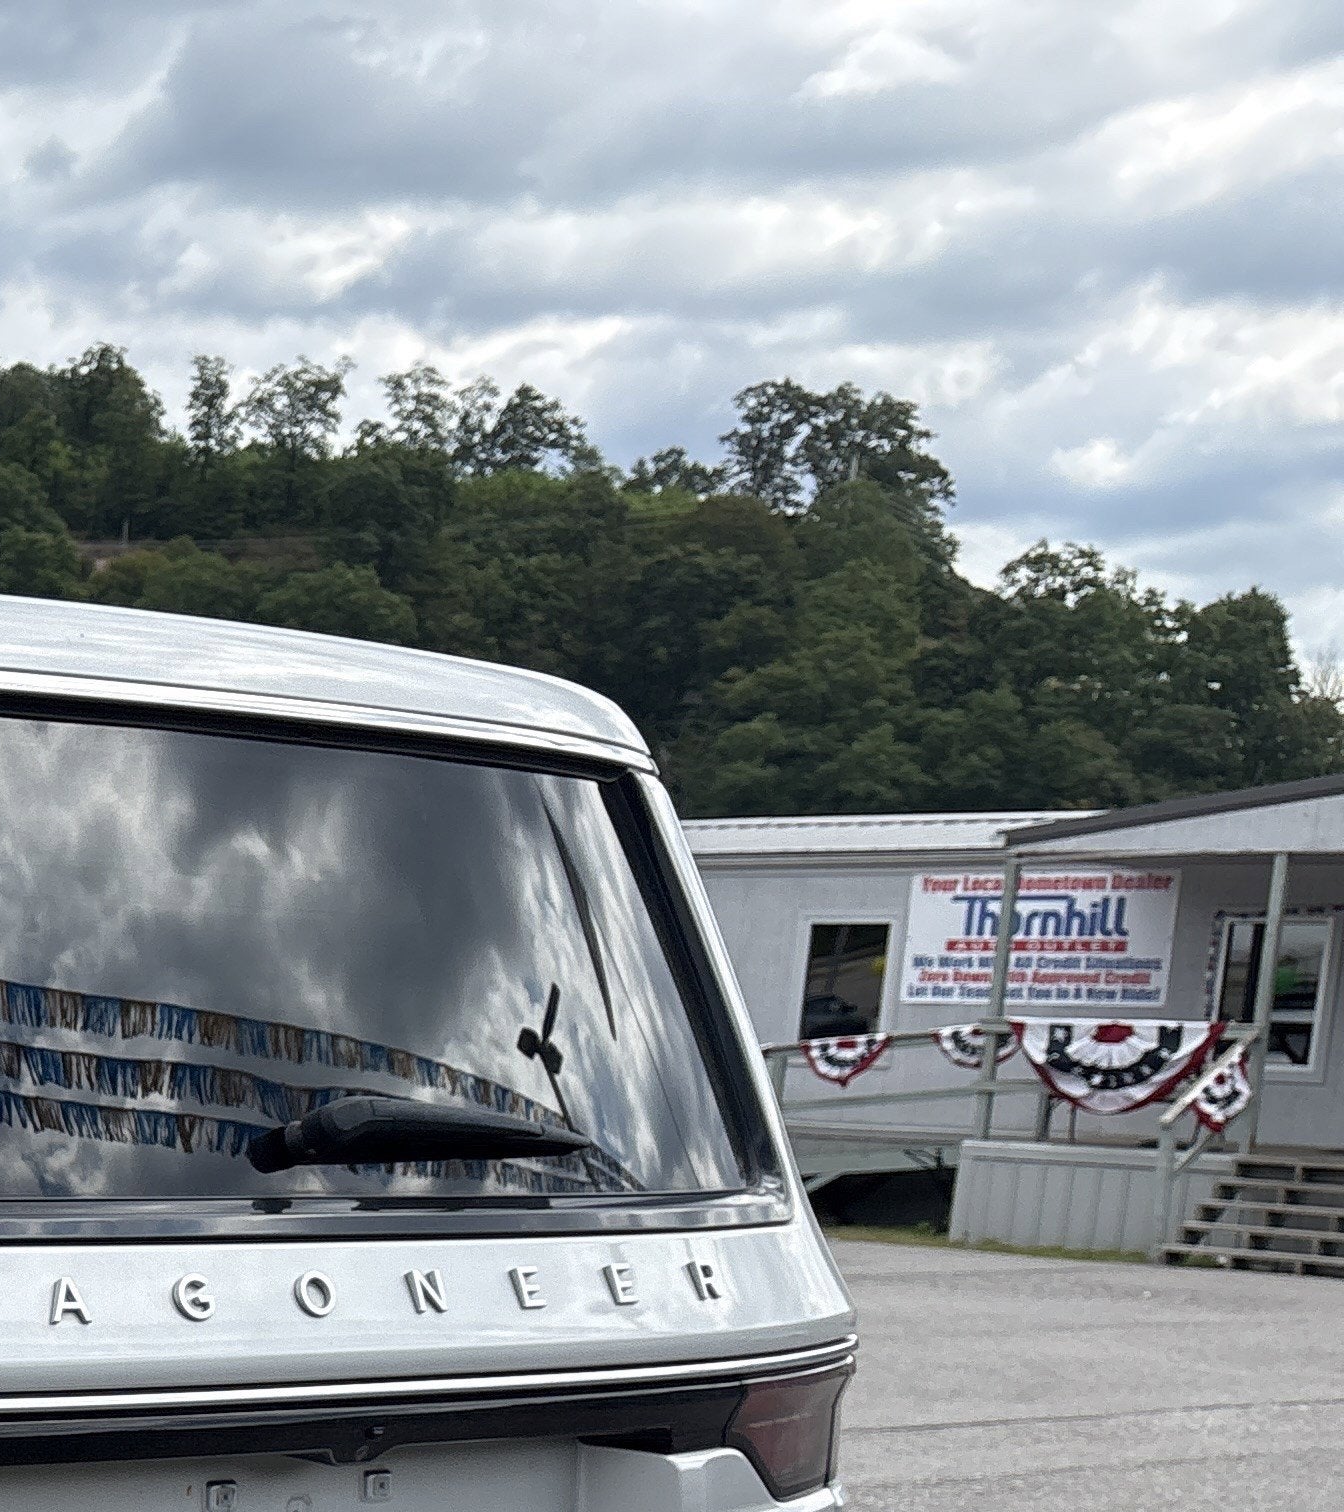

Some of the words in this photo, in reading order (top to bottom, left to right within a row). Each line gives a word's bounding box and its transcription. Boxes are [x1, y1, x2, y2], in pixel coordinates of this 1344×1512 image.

[923, 874, 958, 892] Your
[963, 874, 1002, 891] Loca
[1111, 873, 1172, 890] Dealer
[1026, 940, 1117, 951] OUTLET
